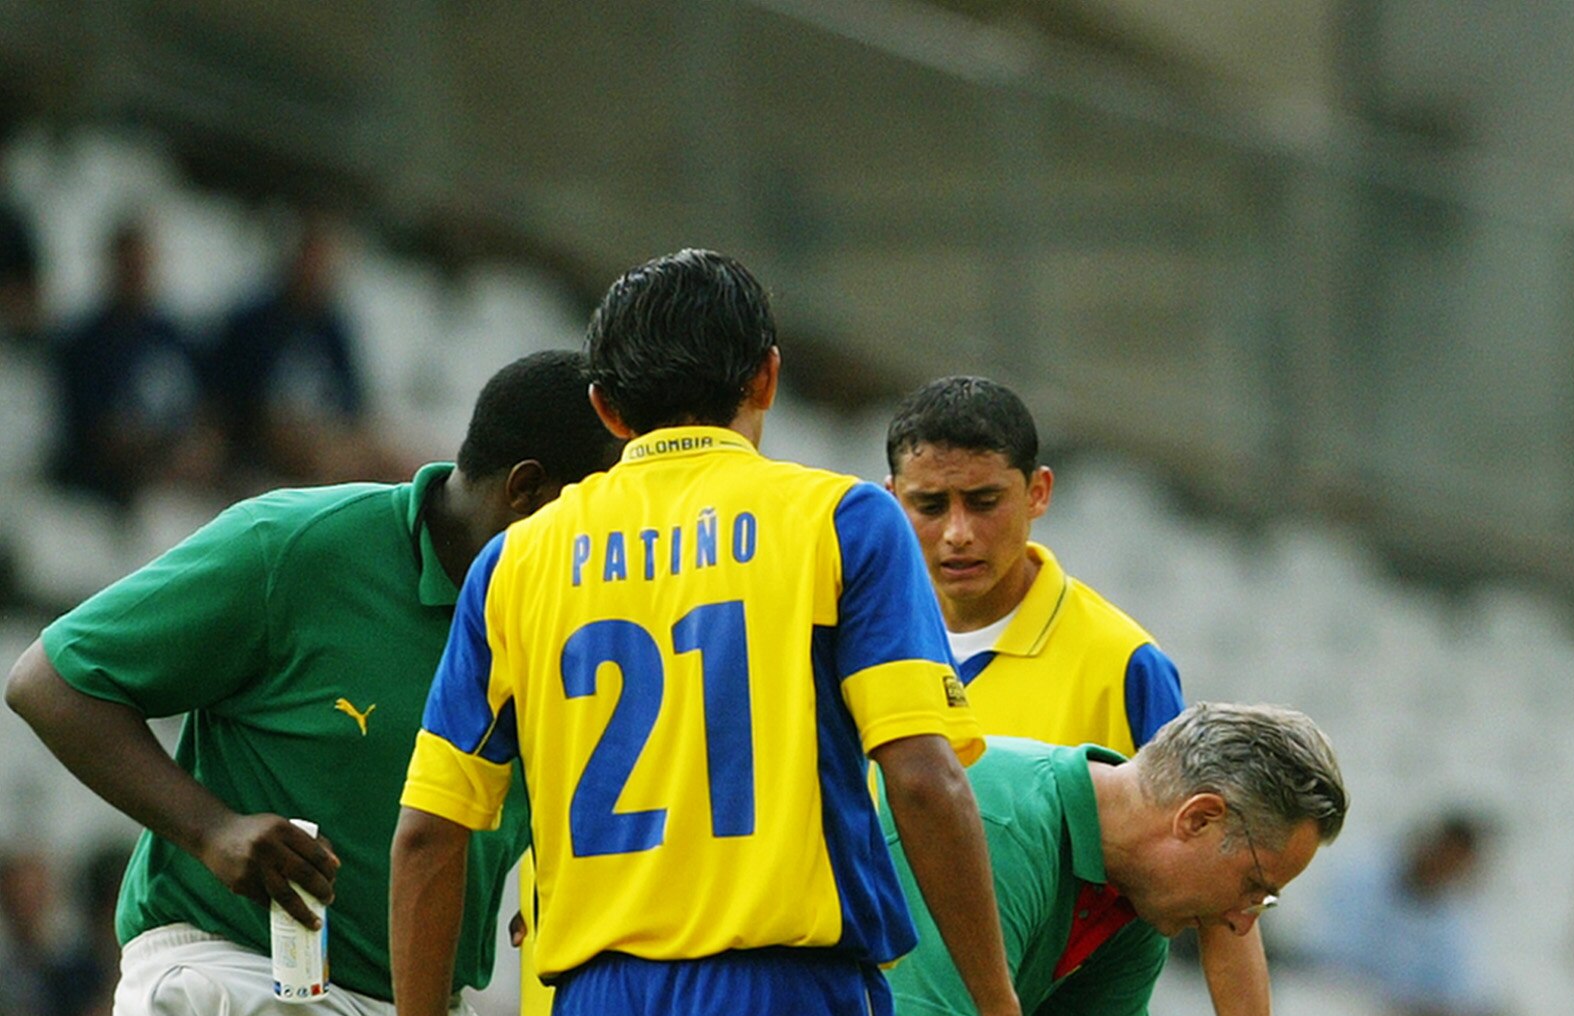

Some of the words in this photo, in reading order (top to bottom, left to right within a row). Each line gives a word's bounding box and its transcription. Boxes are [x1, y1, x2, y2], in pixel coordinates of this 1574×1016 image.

[629, 437, 713, 460] COLOMBIA
[572, 507, 757, 587] PATIÑO
[560, 599, 755, 858] 21
